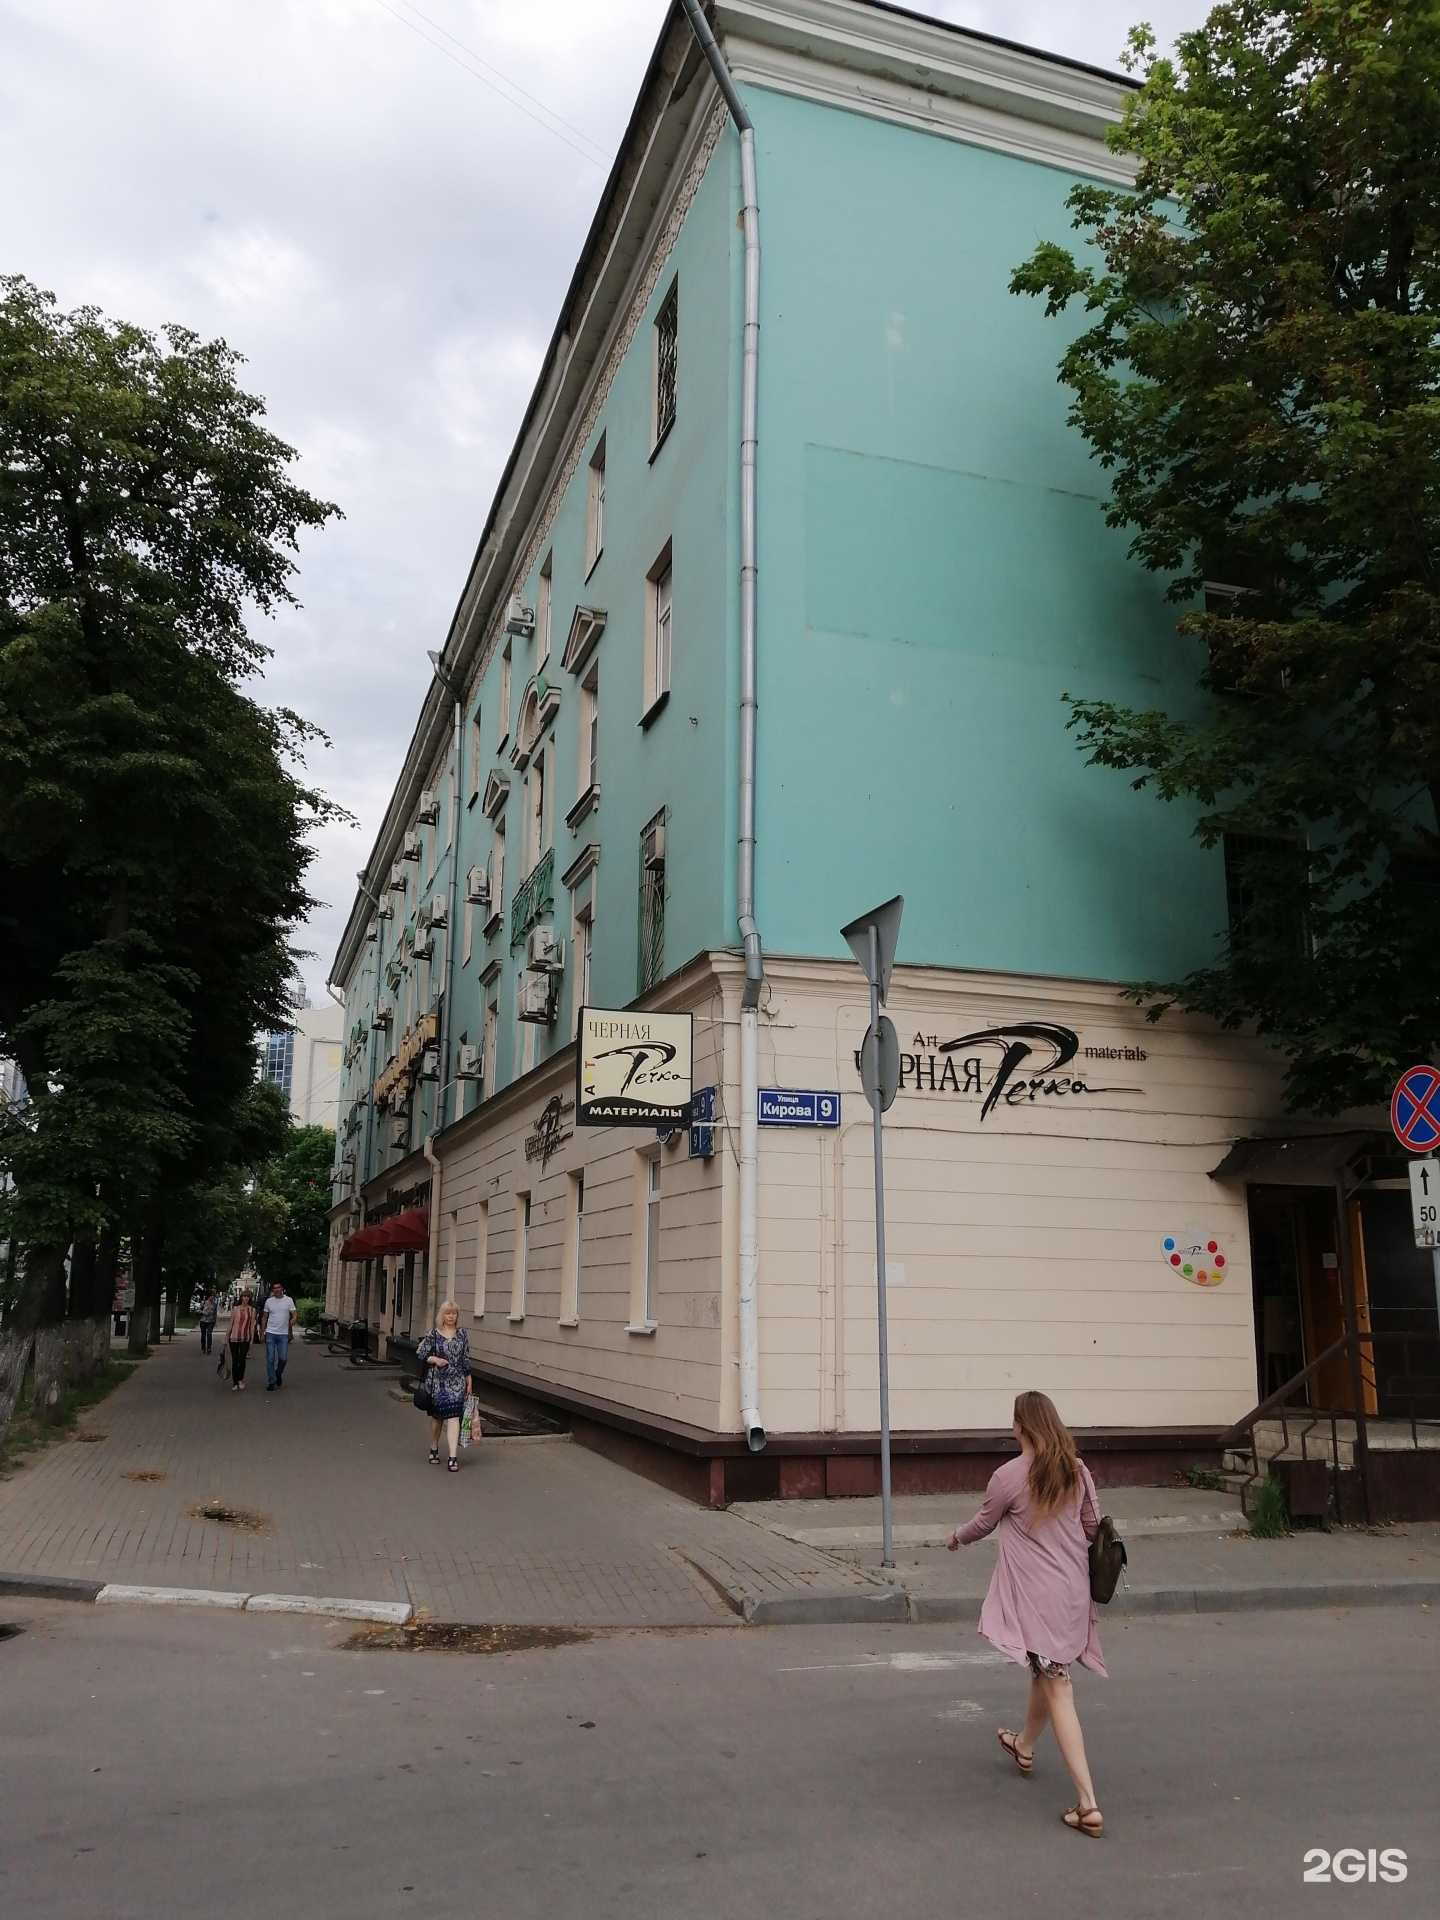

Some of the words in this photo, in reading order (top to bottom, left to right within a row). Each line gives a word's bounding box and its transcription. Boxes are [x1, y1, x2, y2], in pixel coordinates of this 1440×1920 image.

[913, 1031, 939, 1048] Art
[1085, 1045, 1147, 1062] materials
[853, 1050, 983, 1093] РНАЯ
[777, 1095, 799, 1103] Улица
[589, 1106, 682, 1117] МАТЕРИАЛЫ
[763, 1102, 812, 1118] Кирова
[820, 1099, 833, 1117] 9
[1420, 1206, 1437, 1222] 50
